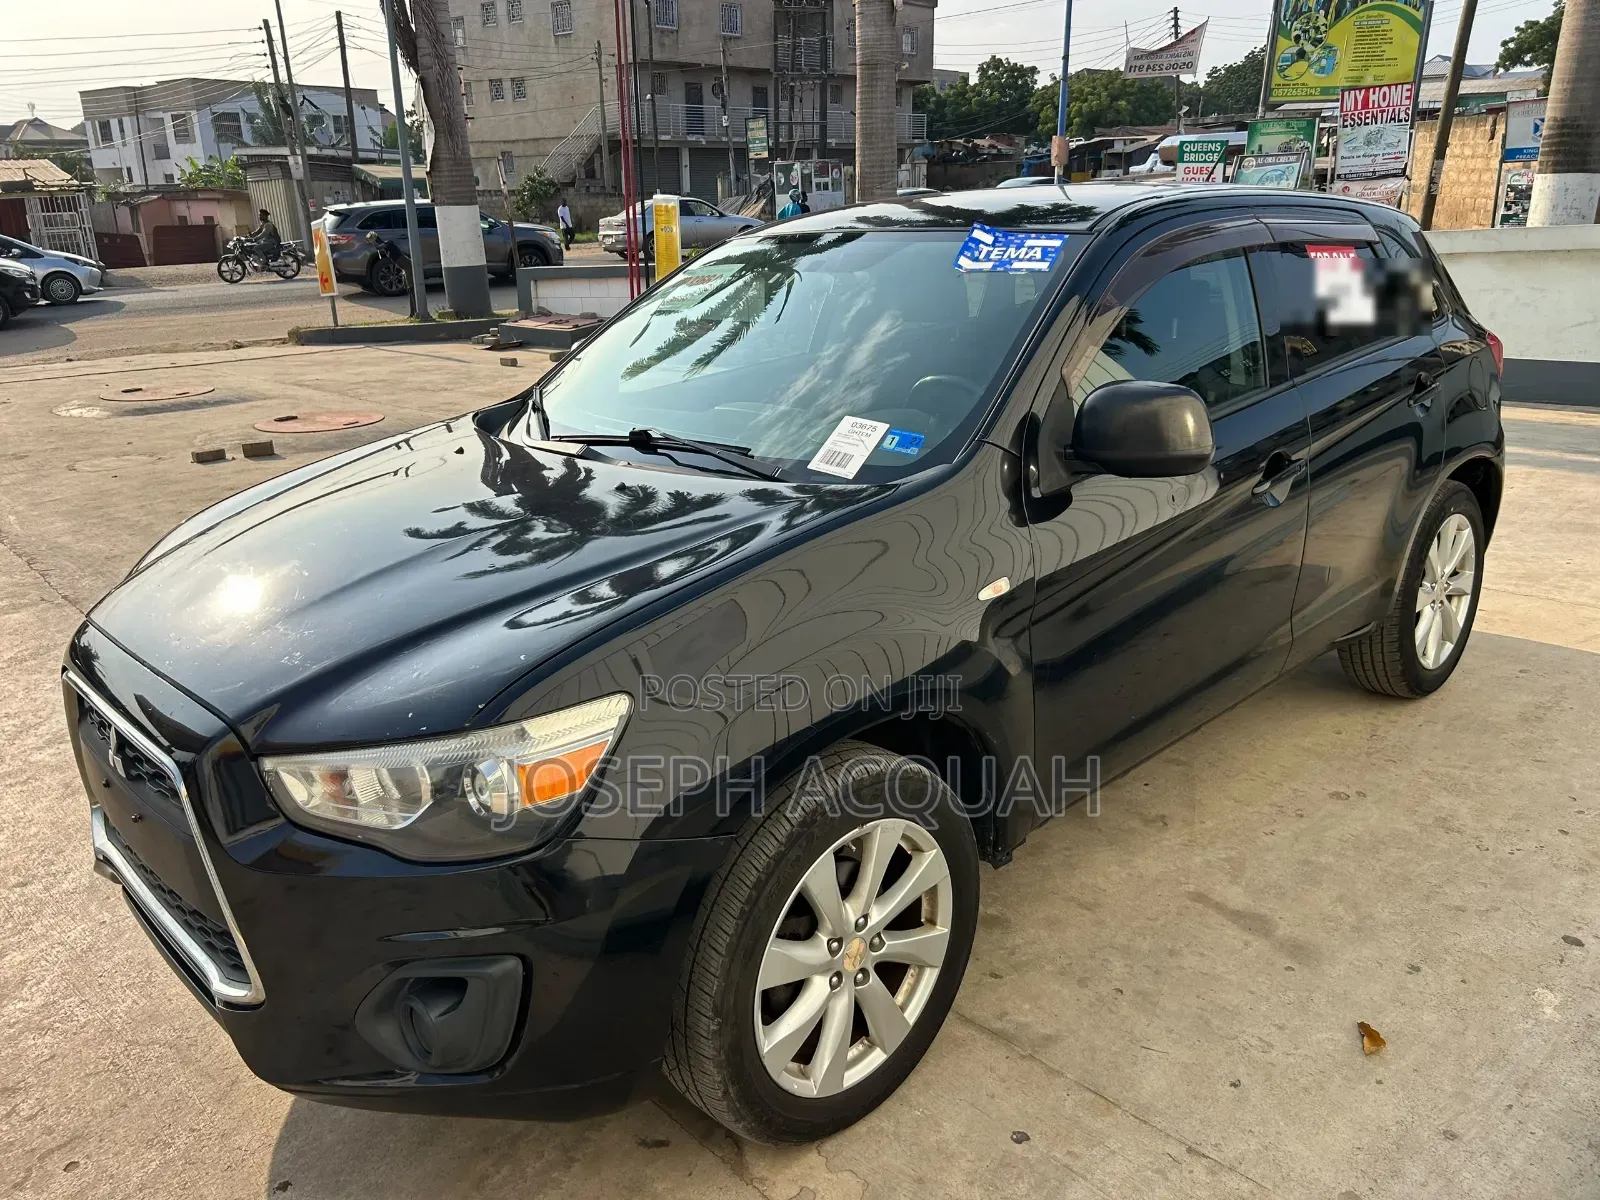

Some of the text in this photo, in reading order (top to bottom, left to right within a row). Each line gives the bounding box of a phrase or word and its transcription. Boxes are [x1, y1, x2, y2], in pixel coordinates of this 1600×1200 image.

[1273, 87, 1321, 97] 0572652142
[1343, 84, 1412, 112] MY HOME
[1342, 106, 1411, 129] ESSENTIALS
[1183, 142, 1221, 152] QUEENS
[1183, 152, 1219, 162] BRIDGE
[978, 243, 1043, 261] TEMA
[850, 421, 879, 433] 03675
[888, 436, 922, 446] 1 27
